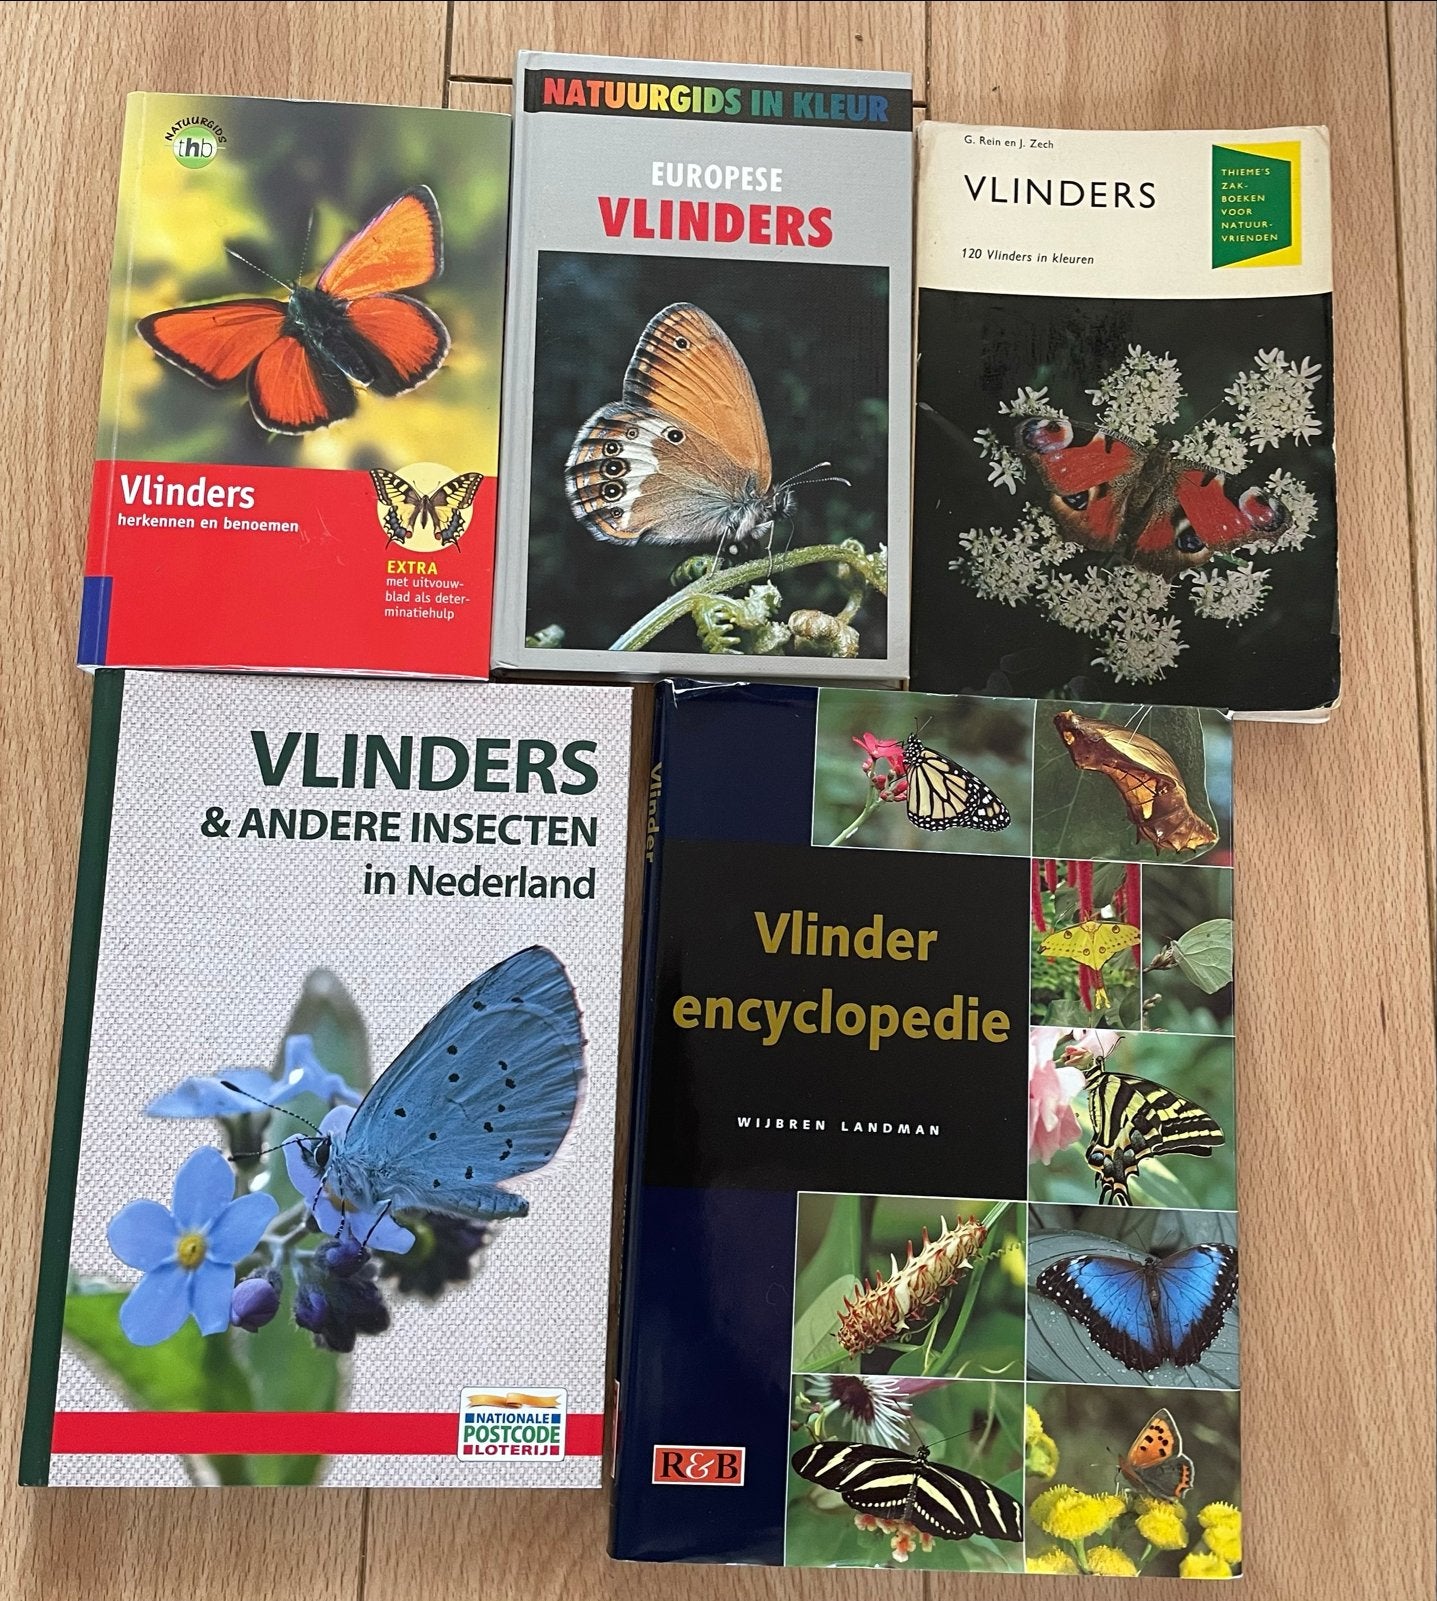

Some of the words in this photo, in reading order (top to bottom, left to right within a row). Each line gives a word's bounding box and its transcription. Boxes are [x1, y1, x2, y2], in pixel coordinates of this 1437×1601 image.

[544, 77, 742, 115] NATUURGIDS
[751, 90, 782, 117] IN
[793, 92, 889, 122] KLEUR
[164, 116, 227, 143] NATUURGIDS
[178, 137, 213, 158] thb
[964, 134, 976, 144] G.
[979, 135, 1001, 146] Rein
[1004, 139, 1017, 147] en
[1019, 138, 1026, 149] J.
[1029, 139, 1054, 149] Zech
[651, 161, 783, 192] EUROPESE
[1221, 168, 1271, 176] THIEME'S
[964, 175, 1156, 208] VLINDERS
[1221, 182, 1248, 190] ZAK-
[1221, 195, 1266, 203] BOEKEN
[1221, 208, 1253, 216] VOOR
[598, 196, 833, 248] VLINDERS
[1221, 221, 1273, 229] NATUUR-
[1221, 234, 1278, 242] VRIENDEN
[962, 248, 982, 259] 120
[987, 249, 1032, 262] Vlinders
[1036, 253, 1048, 263] in
[1052, 253, 1095, 265] kleuren
[120, 474, 256, 509] Vlinders
[117, 512, 195, 528] herkennen
[200, 518, 218, 529] en
[224, 517, 299, 532] benoemen
[386, 560, 438, 575] EXTRA
[386, 577, 408, 587] met
[412, 576, 464, 589] uitvouw-
[385, 591, 411, 603] blad
[414, 591, 431, 603] als
[435, 592, 471, 604] deter-
[384, 606, 455, 621] minatiehulp
[251, 730, 600, 795] VLINDERS
[200, 806, 231, 838] &
[239, 808, 401, 842] ANDERE
[411, 812, 597, 847] INSECTEN
[363, 863, 396, 895] in
[407, 864, 596, 899] Nederland
[754, 910, 939, 961] Vlinder
[673, 988, 1011, 1051] encyclopedie
[737, 1117, 826, 1131] WIJBREN
[840, 1121, 941, 1136] LANDMAN
[475, 1413, 550, 1424] NATIONALE
[463, 1425, 560, 1443] POSTCODE
[475, 1444, 549, 1456] LOTERIJ
[660, 1451, 739, 1480] R&B
